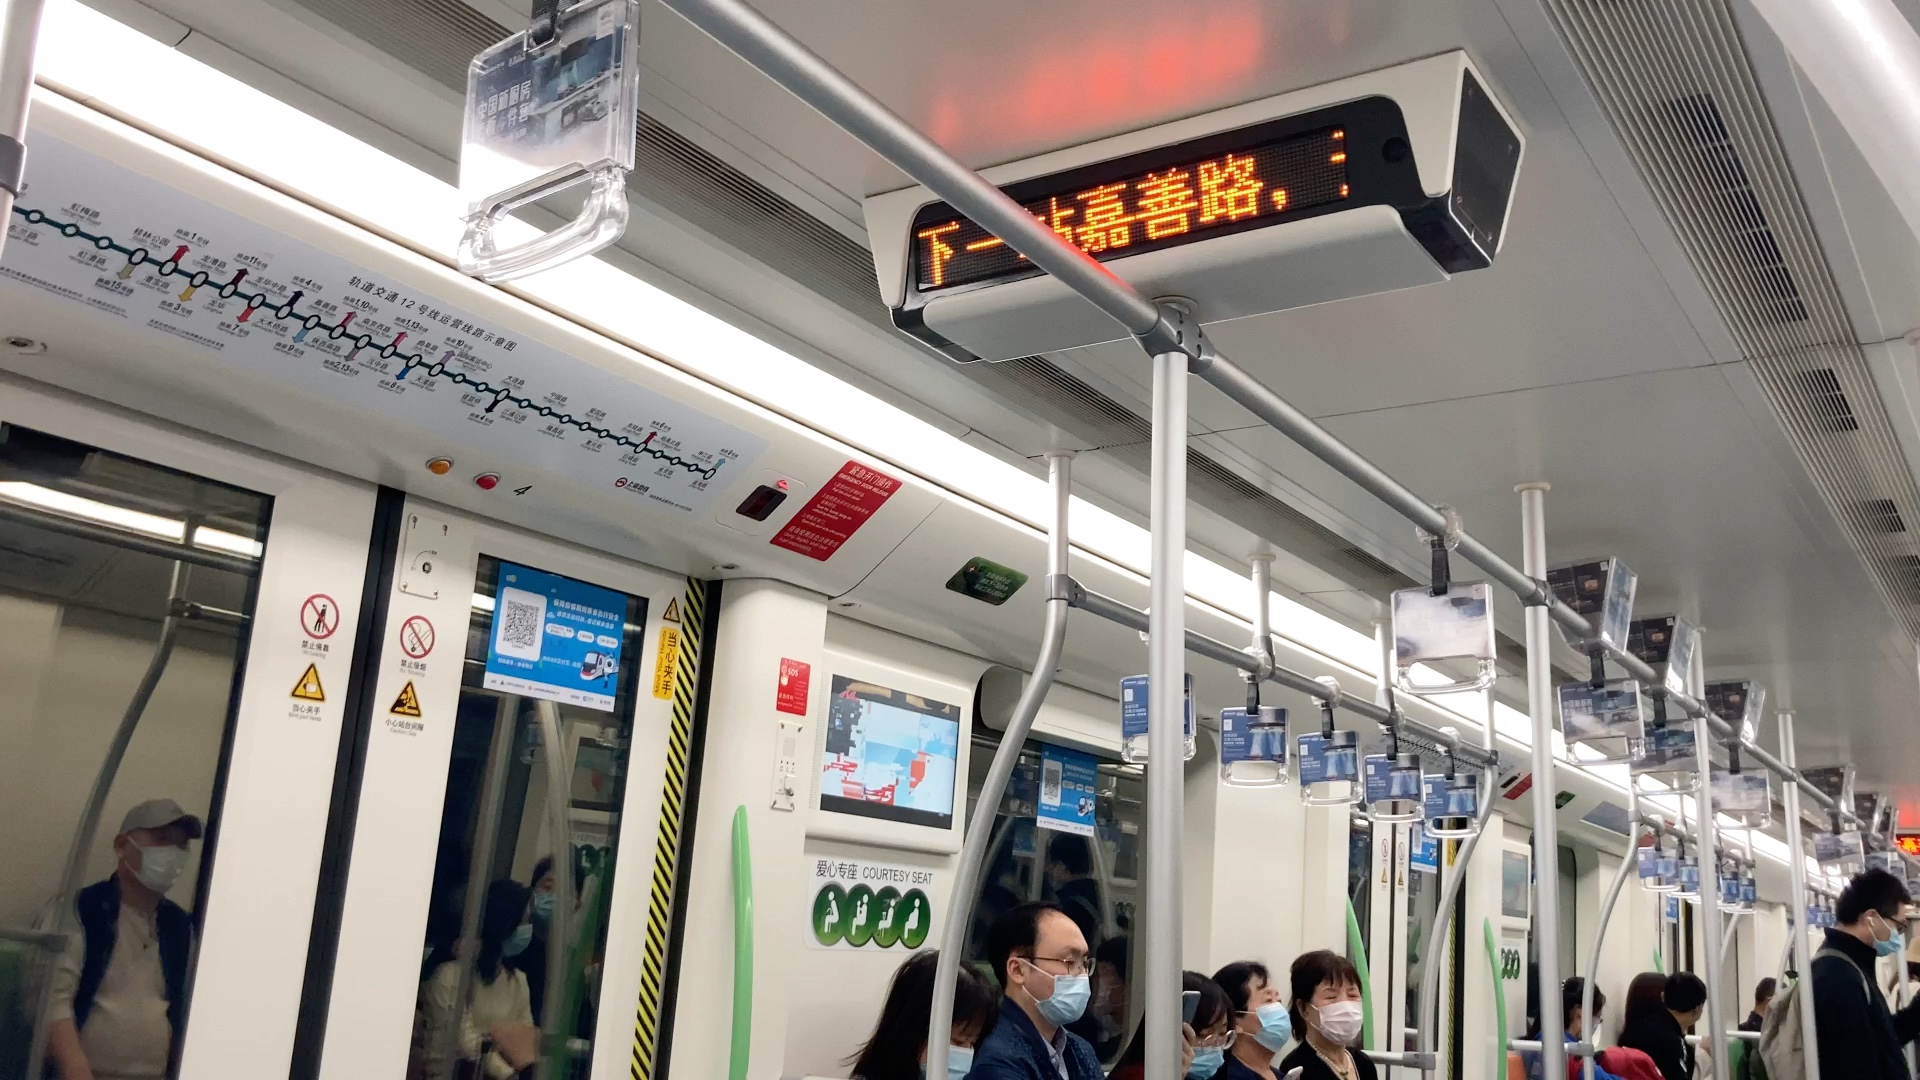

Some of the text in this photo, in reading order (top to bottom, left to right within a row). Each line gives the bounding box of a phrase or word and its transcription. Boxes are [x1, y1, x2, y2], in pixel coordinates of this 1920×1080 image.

[661, 631, 678, 696] 当心夹手
[787, 667, 799, 677] SOS
[816, 860, 933, 885] 爱心专座 COURTESY SEAT
